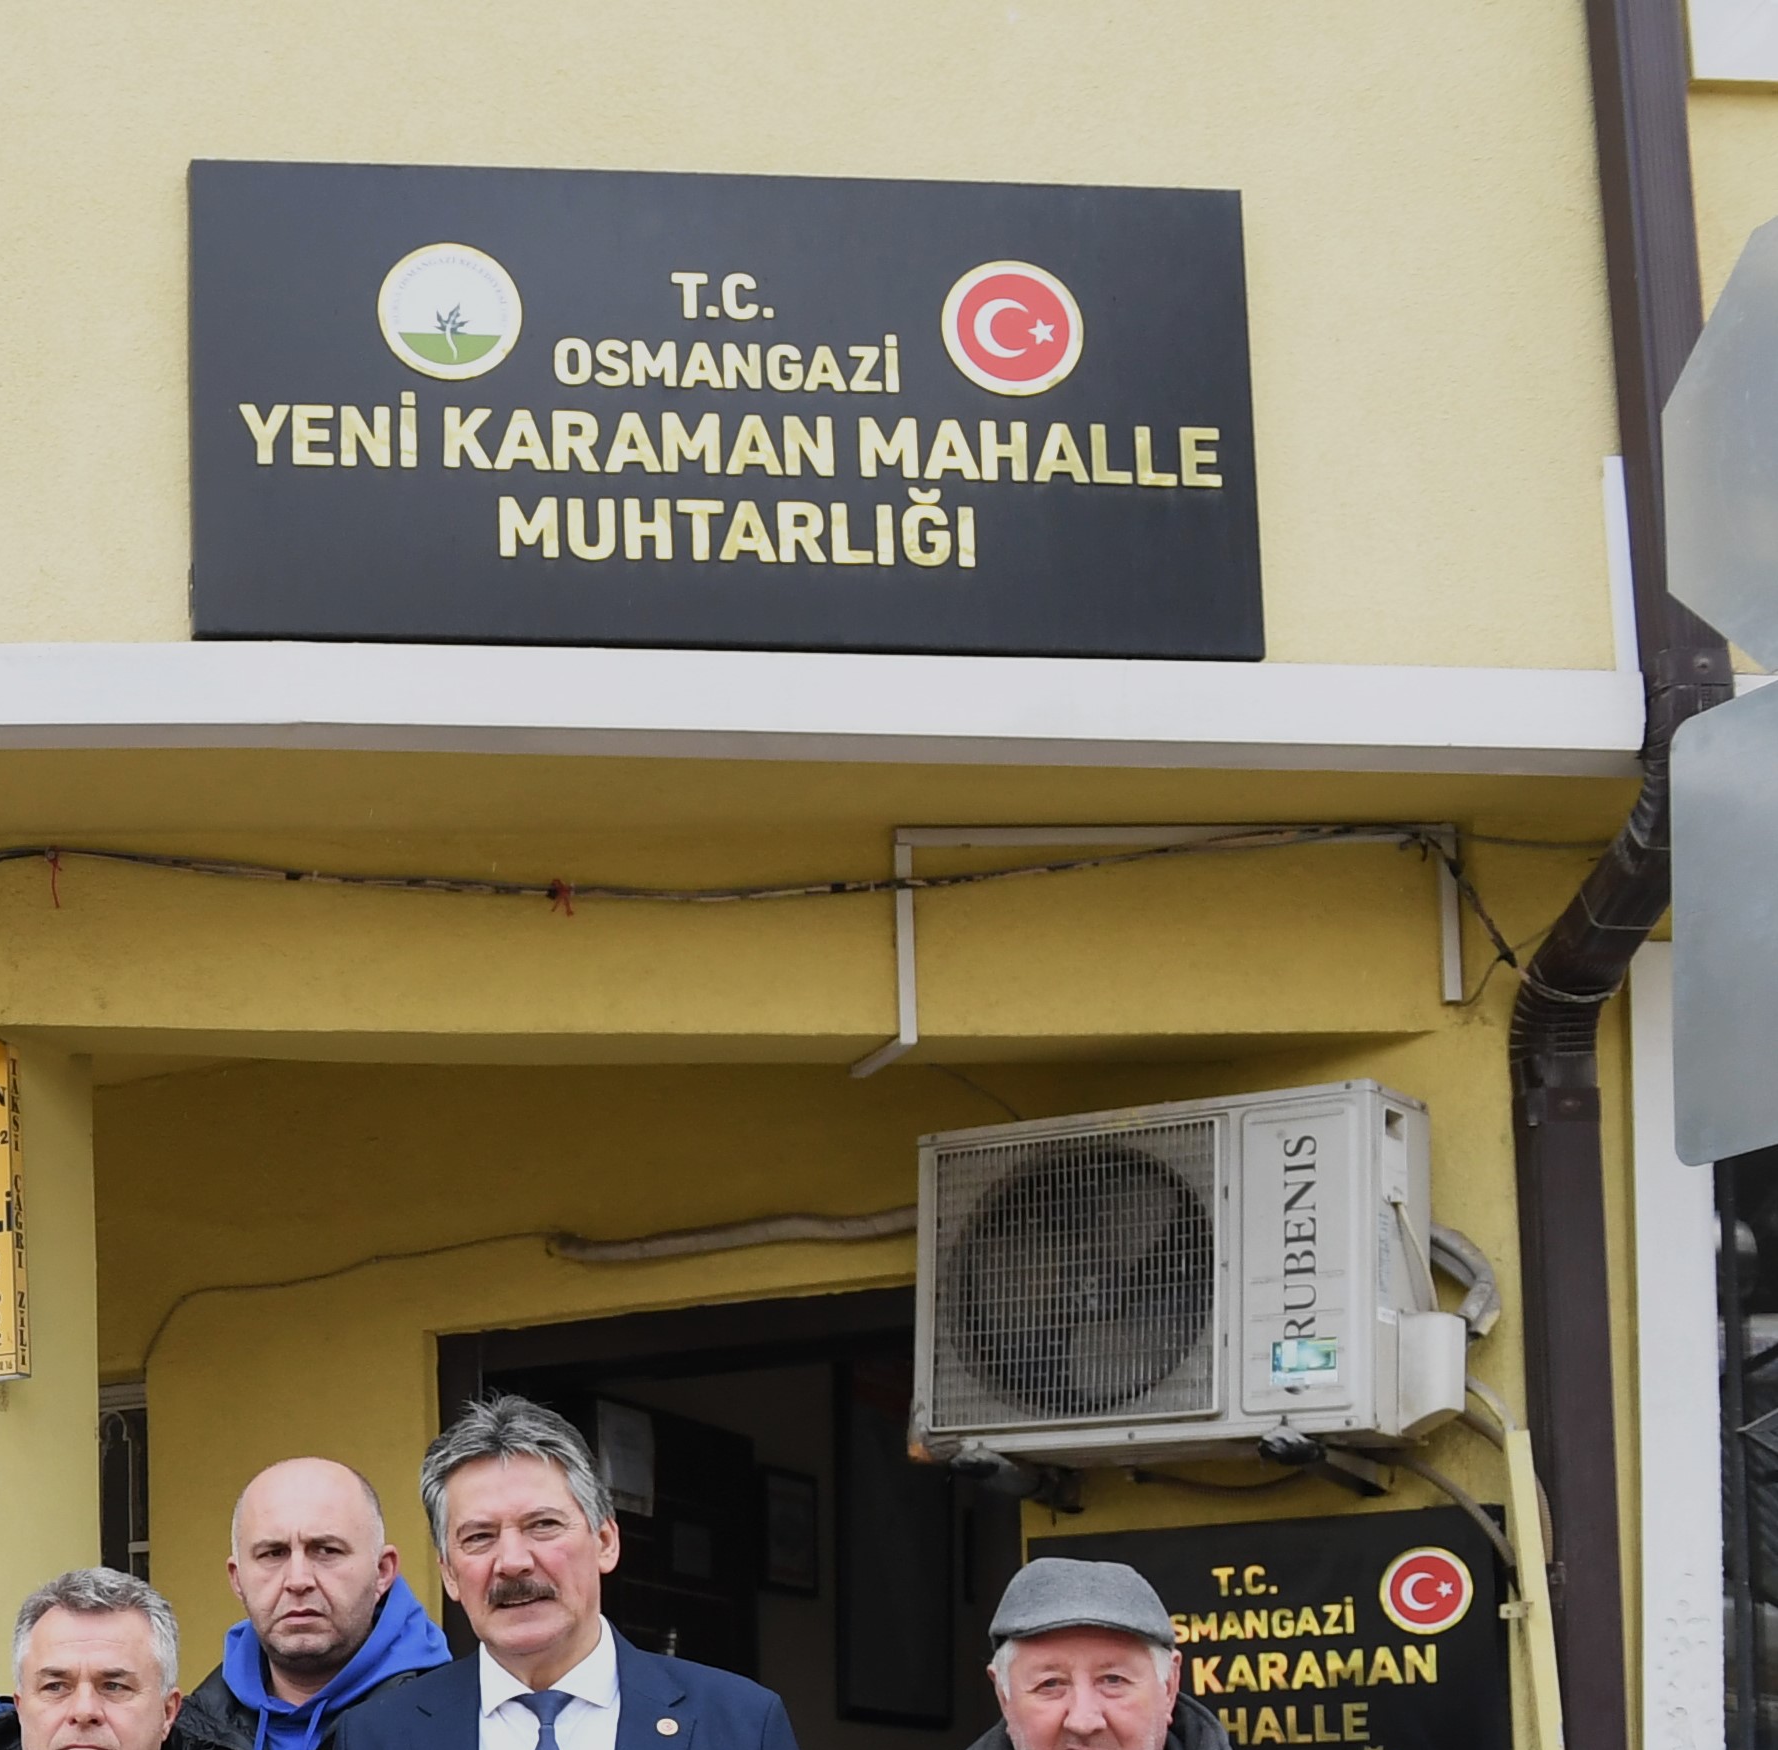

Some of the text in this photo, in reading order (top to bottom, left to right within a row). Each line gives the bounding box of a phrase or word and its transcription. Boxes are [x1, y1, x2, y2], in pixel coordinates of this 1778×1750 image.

[671, 271, 774, 321] T.C.
[554, 335, 900, 394] OSMANGAZİ
[239, 391, 1221, 489] YENİ KARAMAN MAHALLE
[497, 487, 977, 569] MUHTARLIĞI
[1284, 1134, 1317, 1395] RUBENIS
[1211, 1565, 1278, 1597] T.C.
[1171, 1597, 1355, 1644] SMANGAZİ
[1192, 1644, 1438, 1696] KARAMAN
